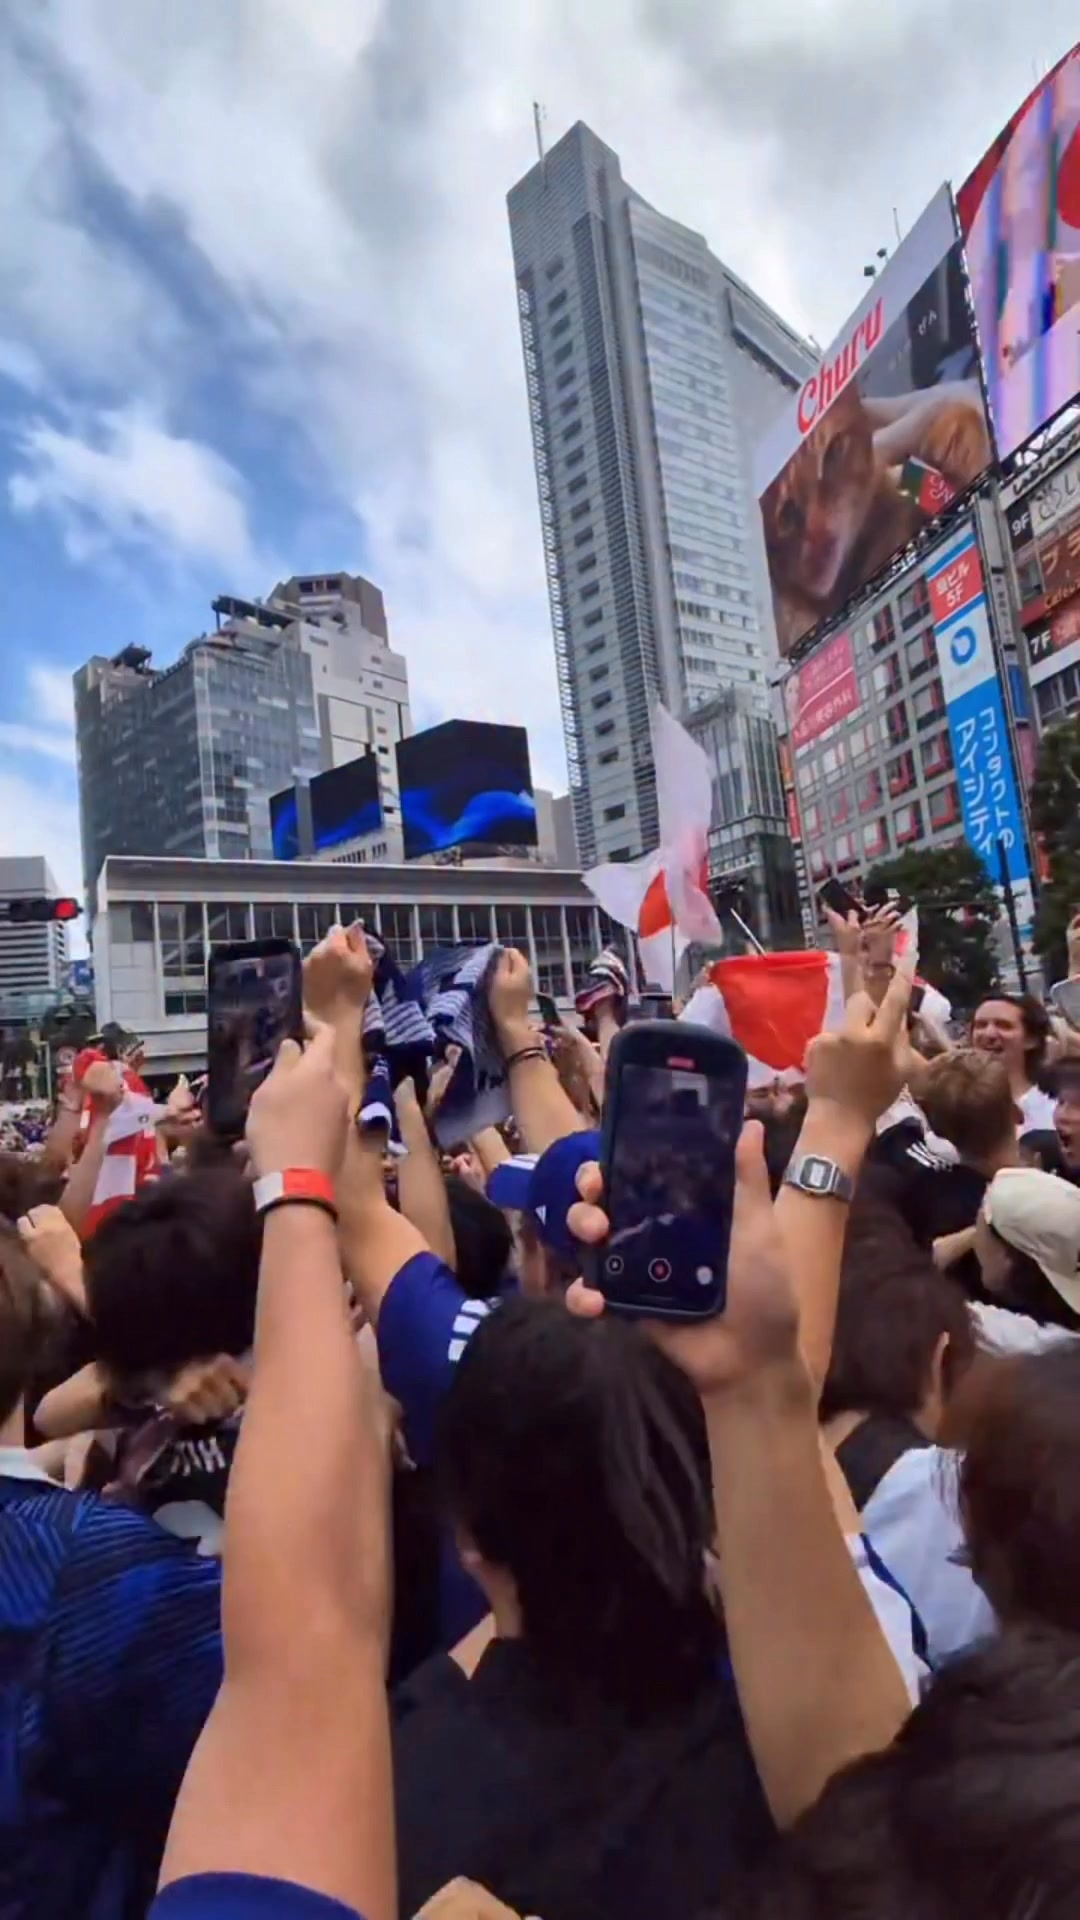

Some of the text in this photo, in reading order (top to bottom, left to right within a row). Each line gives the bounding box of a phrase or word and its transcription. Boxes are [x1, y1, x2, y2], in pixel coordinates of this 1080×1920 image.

[798, 297, 884, 436] Churu
[1012, 512, 1030, 537] 9F
[1030, 628, 1052, 656] 7F
[955, 715, 994, 856] アイシティ
[979, 705, 1016, 849] コンタクトの
